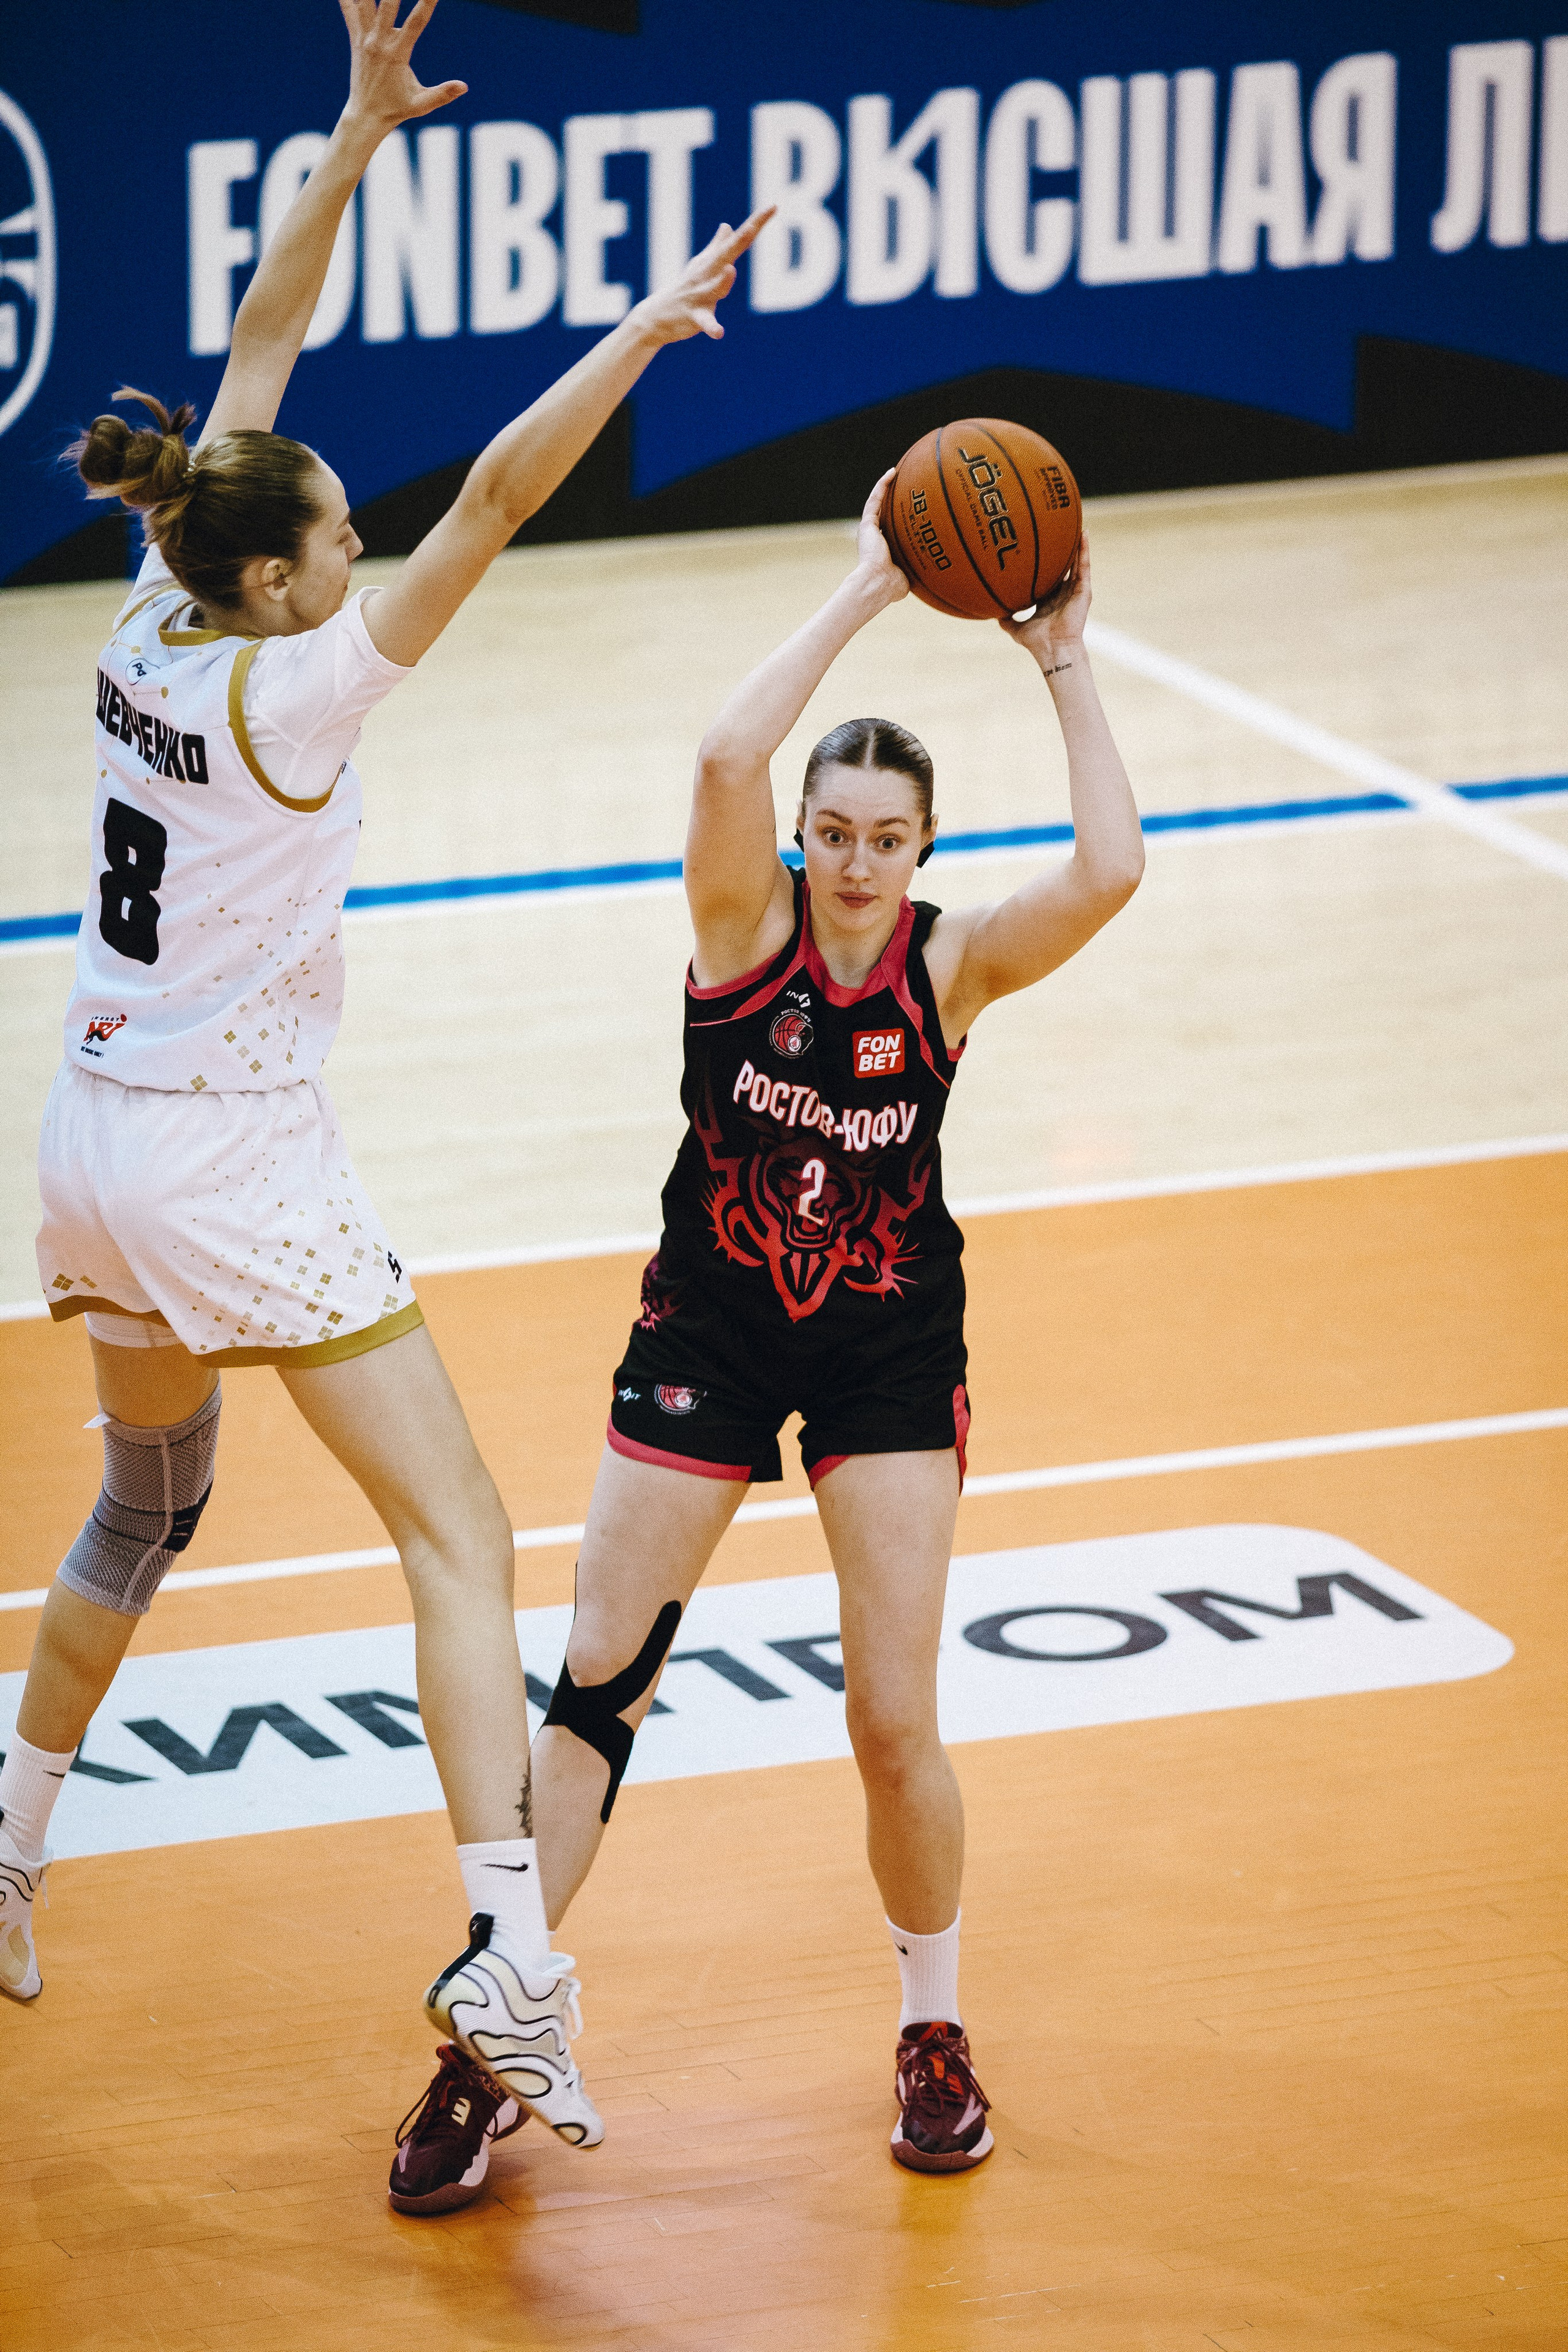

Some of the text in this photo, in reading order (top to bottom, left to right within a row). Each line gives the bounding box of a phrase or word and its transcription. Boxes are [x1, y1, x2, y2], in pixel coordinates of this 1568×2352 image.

[749, 51, 1398, 314] ВЫСШАЯ
[958, 447, 1018, 571] JÖGEL
[1047, 467, 1071, 508] FIBA
[911, 489, 952, 571] JB-1000
[978, 529, 988, 550] BALL
[99, 797, 167, 965] 8
[858, 1034, 900, 1054] FON
[858, 1050, 901, 1072] BET
[733, 1059, 918, 1153] РОСТОВ-ЮФУ
[797, 1158, 826, 1226] 2
